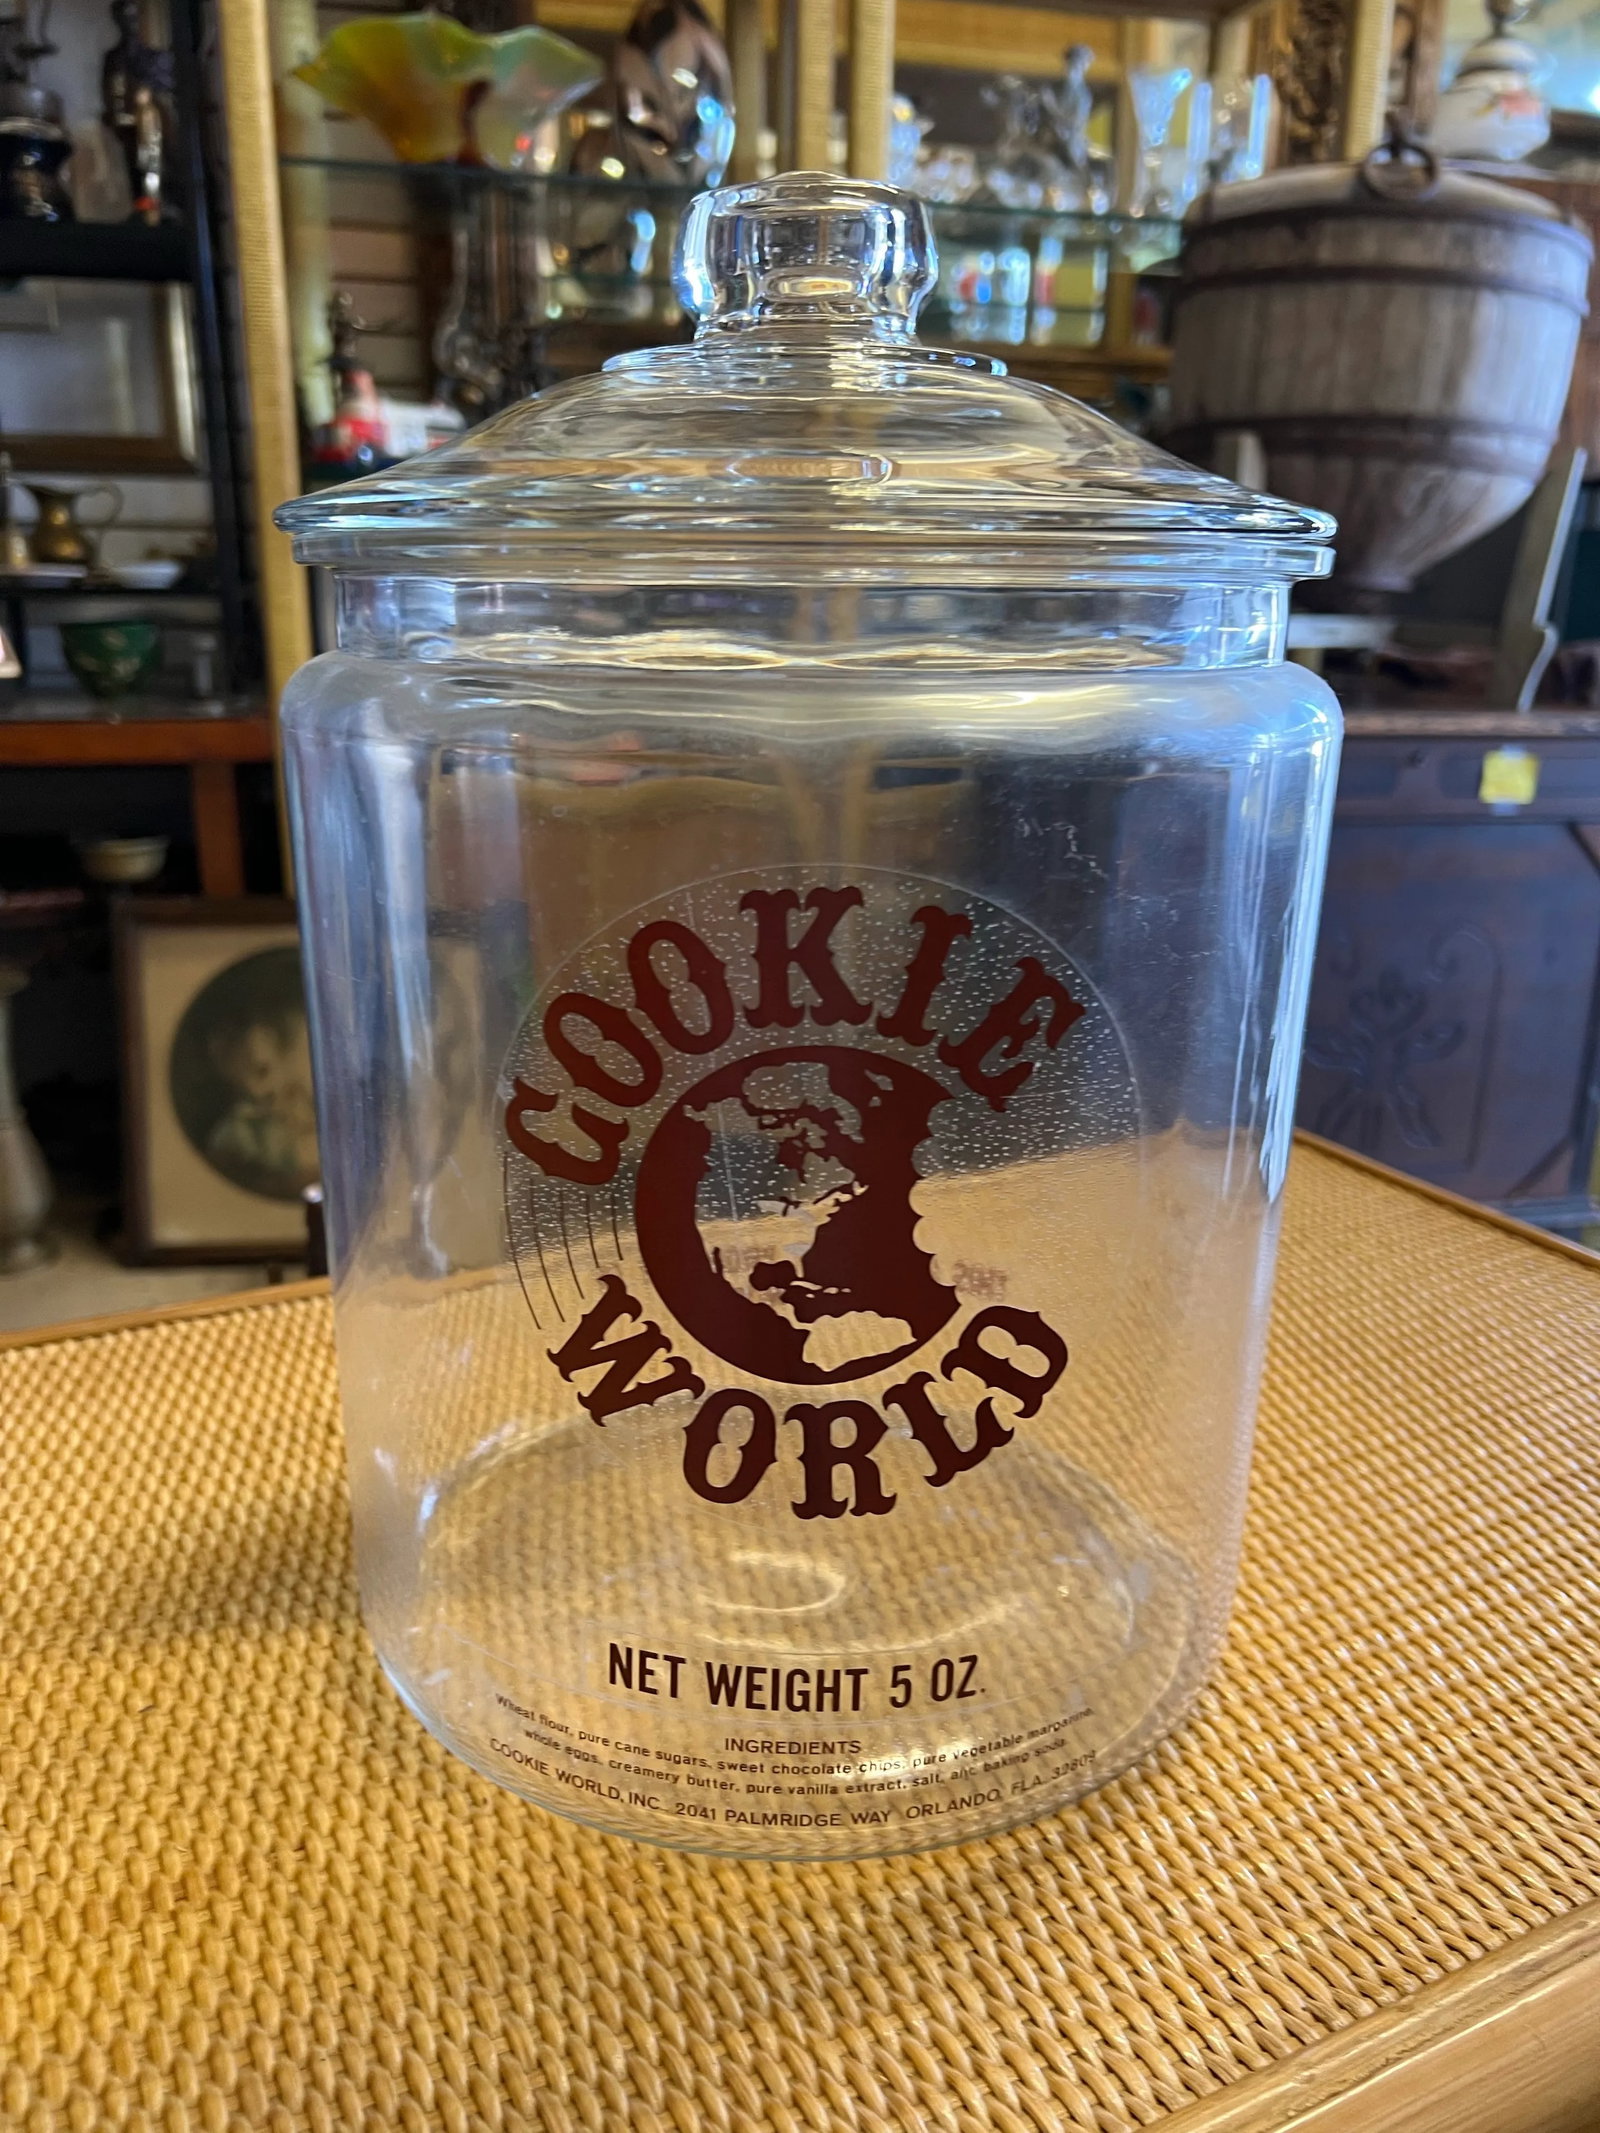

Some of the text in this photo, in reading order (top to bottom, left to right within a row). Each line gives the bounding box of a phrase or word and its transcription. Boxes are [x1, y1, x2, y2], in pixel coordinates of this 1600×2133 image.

[505, 886, 1086, 1186] COOKIE
[546, 1274, 1069, 1520] WORLD
[609, 1642, 987, 1712] NET WEIGHT 5 OZ.
[495, 1692, 535, 1721] Wheat
[579, 1730, 610, 1747] pure
[614, 1741, 650, 1757] cane
[717, 1760, 764, 1774] sweet
[772, 1763, 851, 1775] chocolate
[913, 1751, 946, 1768] pure
[953, 1733, 1024, 1760] vegetable
[524, 1728, 562, 1751] whole
[609, 1758, 680, 1784] creamery
[746, 1783, 782, 1795] pure
[788, 1783, 839, 1795] vanilla
[983, 1750, 1031, 1773] baking
[725, 1737, 862, 1755] INGREDIENTS
[489, 1738, 551, 1776] COOKIE
[675, 1802, 716, 1820] 2041
[724, 1808, 843, 1827] PALMRIDGE
[850, 1809, 892, 1825] WAY
